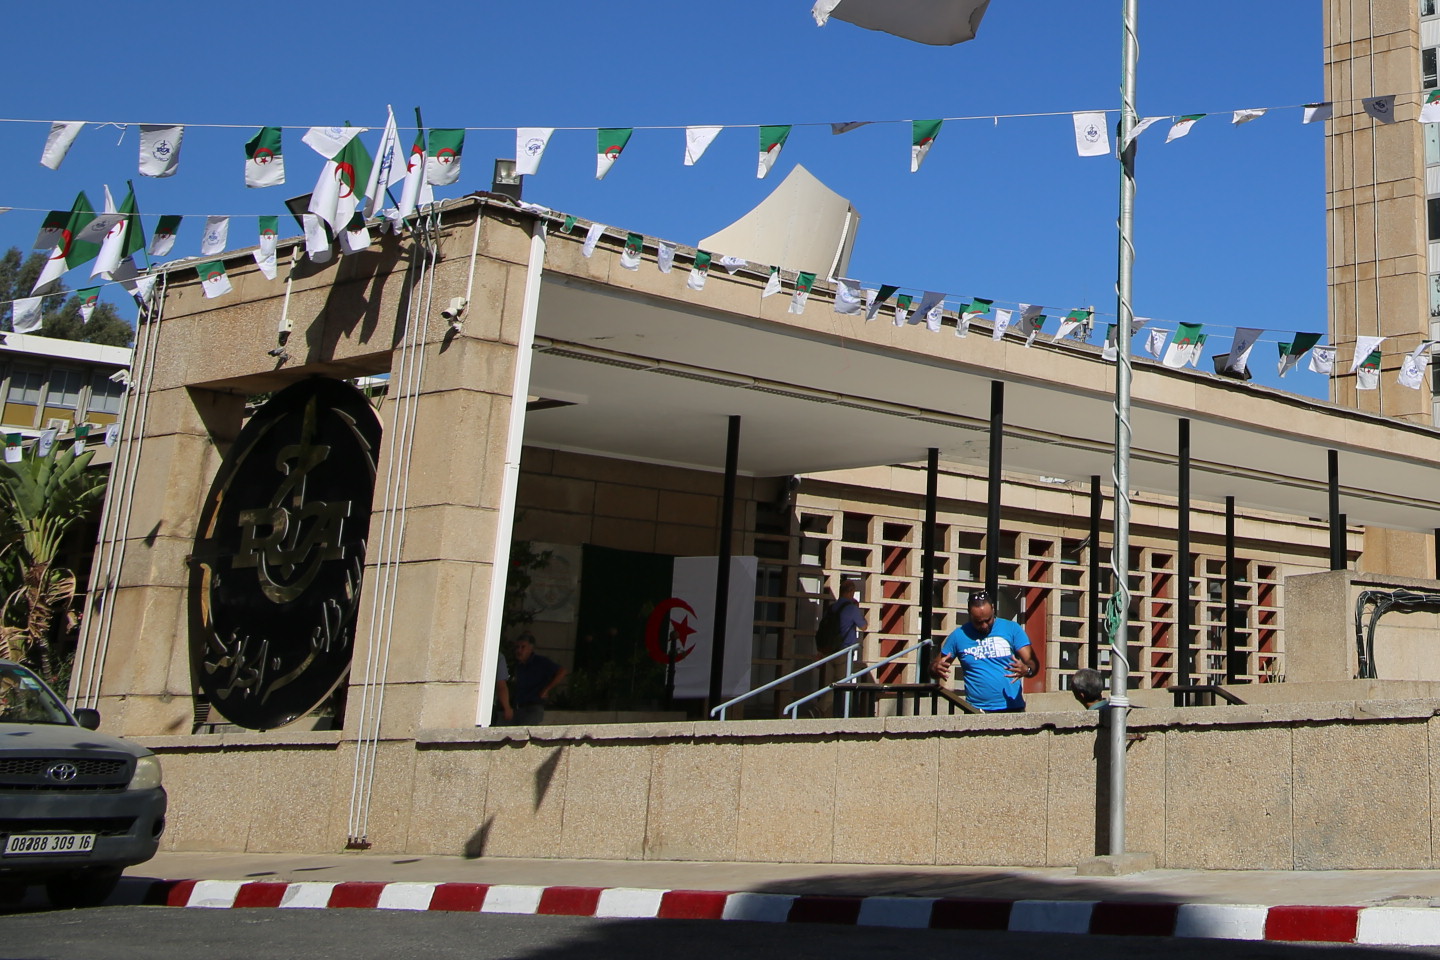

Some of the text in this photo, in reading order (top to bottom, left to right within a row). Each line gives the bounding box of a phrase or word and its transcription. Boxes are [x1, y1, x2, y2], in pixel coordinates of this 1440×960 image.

[975, 637, 994, 646] THE
[963, 643, 995, 656] NORTH
[974, 651, 997, 660] FACE
[52, 836, 75, 850] 309
[79, 835, 91, 849] 16
